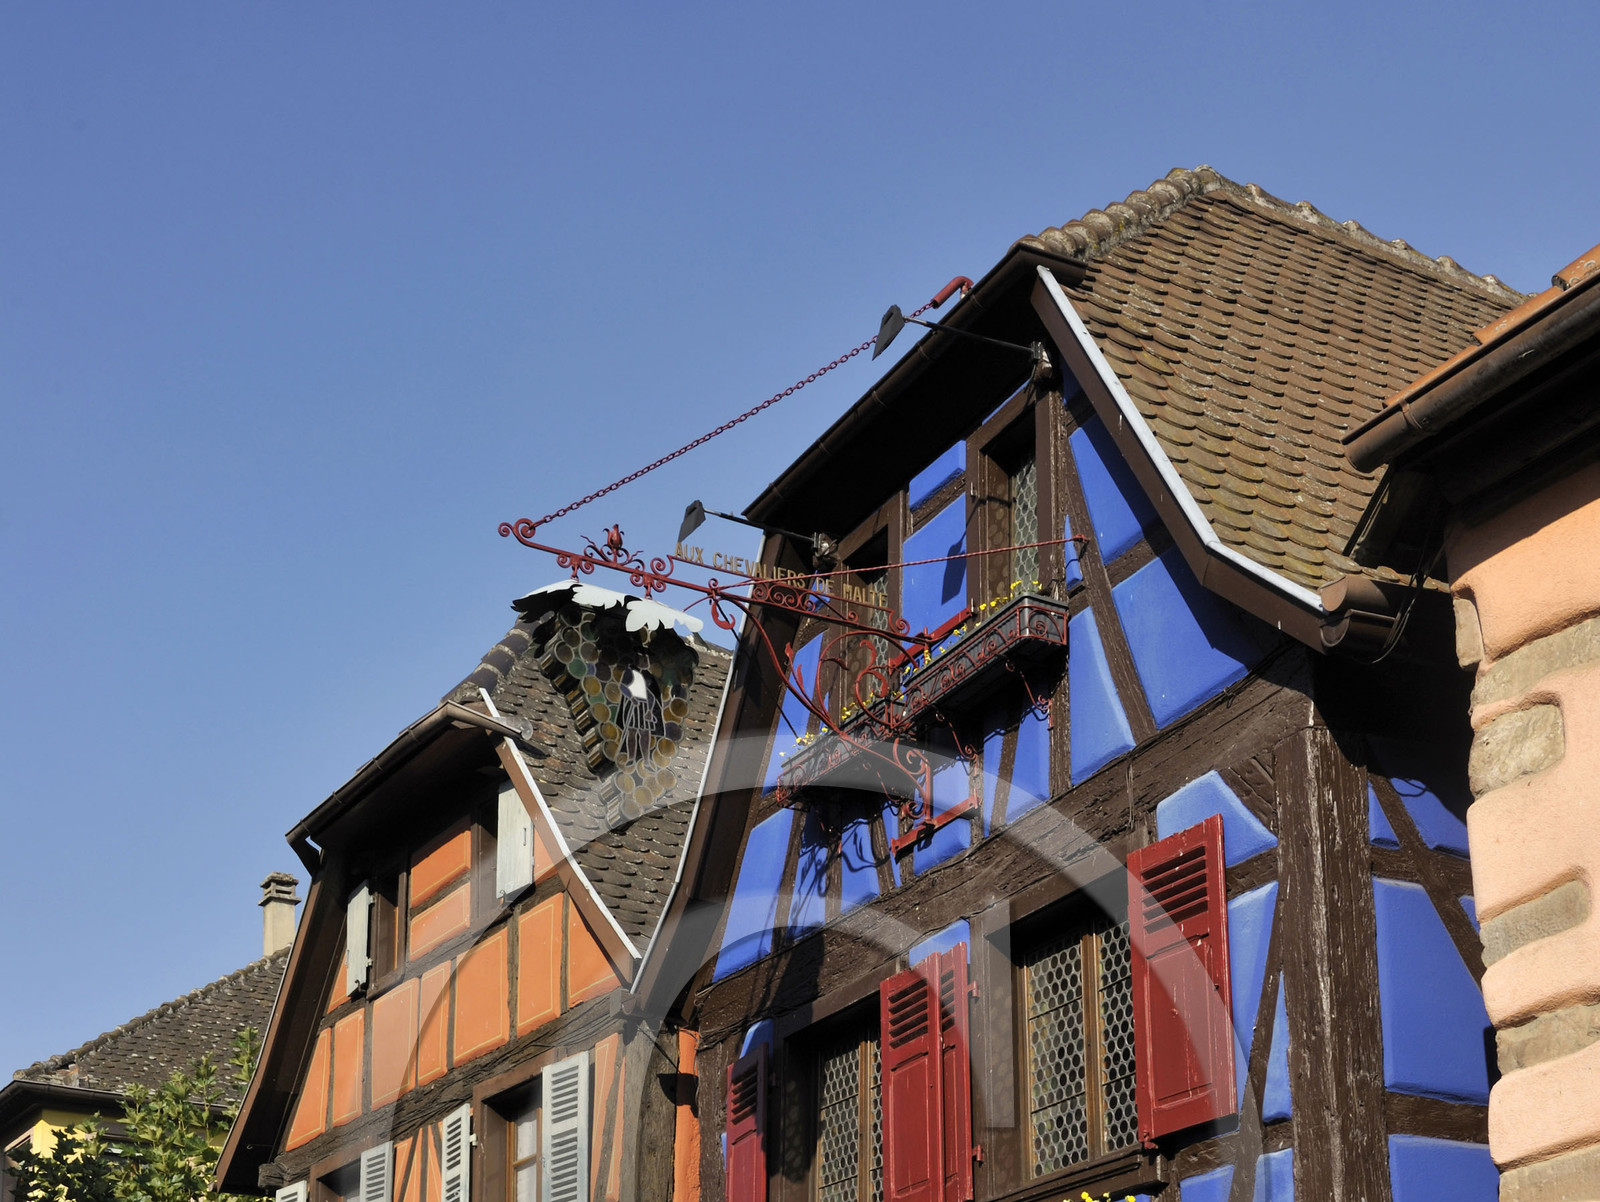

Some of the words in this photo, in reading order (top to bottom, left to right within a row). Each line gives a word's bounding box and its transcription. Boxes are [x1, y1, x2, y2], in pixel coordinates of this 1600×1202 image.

[674, 541, 704, 566] AUX
[713, 552, 806, 589] CHEVALIERS
[816, 576, 835, 596] DE
[842, 582, 888, 608] MALTE
